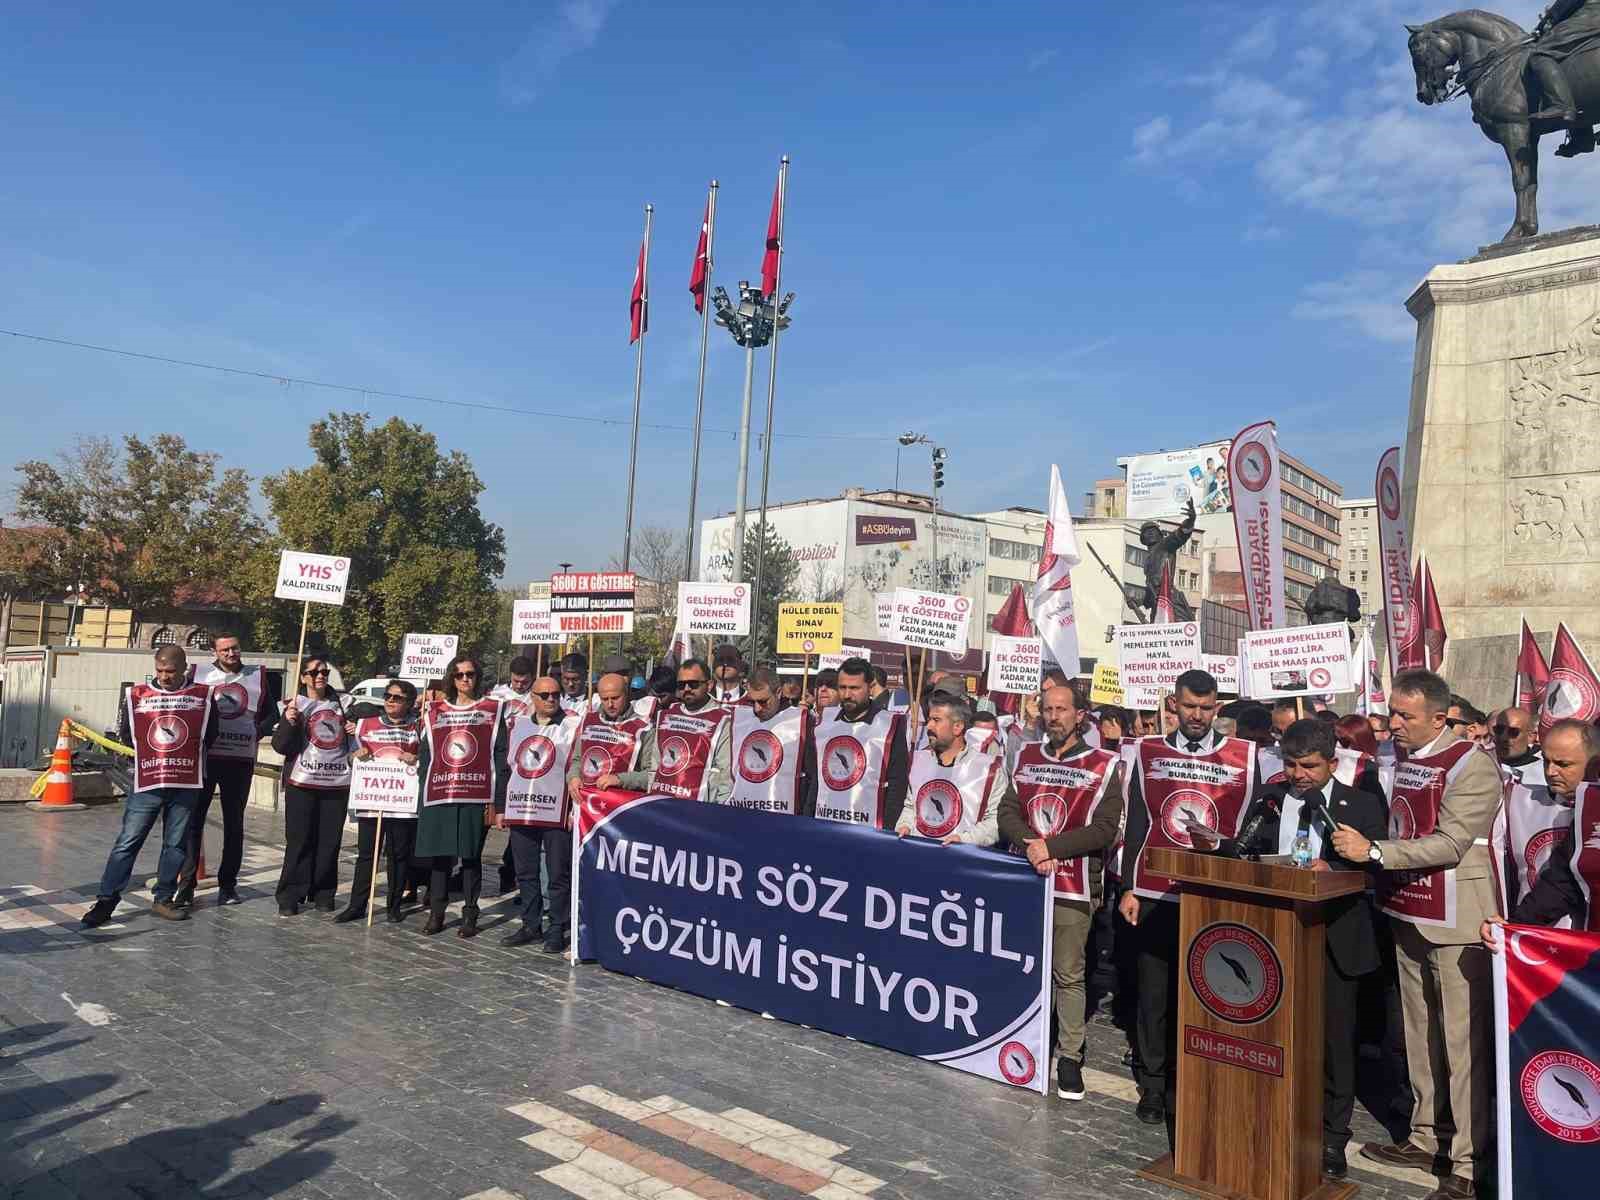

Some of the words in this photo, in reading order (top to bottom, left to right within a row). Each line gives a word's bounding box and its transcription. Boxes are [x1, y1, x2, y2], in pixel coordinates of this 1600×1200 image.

[862, 523, 911, 537] #ASBÜdeyim
[298, 563, 333, 580] YHS
[282, 579, 342, 593] KALDIRILSIN
[552, 574, 577, 591] 3600
[578, 574, 590, 591] EK
[591, 573, 635, 591] GÖSTERGE
[551, 595, 567, 609] TÜM
[568, 597, 590, 609] KAMU
[686, 594, 742, 608] GELİŞTİRME
[918, 595, 946, 608] 3600
[518, 609, 551, 620] GELİŞTİ
[692, 606, 735, 618] ÖDENEĞİ
[782, 605, 811, 615] HÜLLE
[896, 604, 910, 614] EK
[911, 605, 965, 622] GÖSTERGE
[523, 620, 551, 630] ÖDENE
[560, 614, 624, 631] VERİLSİN!!!
[689, 621, 737, 631] HAKKIMIZ
[796, 619, 823, 627] SINAV
[900, 614, 920, 625] İÇİN
[921, 619, 944, 629] DAHA
[946, 623, 958, 631] NE
[521, 633, 560, 641] HAKKIMIZ
[899, 624, 927, 636] KADAR
[928, 629, 957, 640] KARAR
[1250, 636, 1285, 648] MEMUR
[1286, 628, 1343, 642] EMEKLİLERİ
[408, 636, 432, 646] HÜLLE
[904, 634, 945, 647] ALINACAK
[1123, 640, 1168, 649] MEMLEKETE
[1170, 638, 1194, 647] TAYİN
[420, 645, 445, 655] DEĞİL
[1015, 643, 1040, 655] 3600
[1301, 643, 1324, 654] LİRA
[405, 655, 434, 665] SINAV
[996, 653, 1008, 662] EK
[1146, 651, 1171, 659] HAYAL
[1282, 657, 1308, 667] MAAŞ
[1310, 654, 1346, 665] ALIYOR
[409, 665, 448, 675] İSTİYORU
[1124, 662, 1158, 671] MEMUR
[1159, 660, 1193, 670] KİRAYI
[1000, 673, 1025, 681] KADAR
[1128, 675, 1155, 684] NASIL
[1005, 681, 1038, 691] ALINACA
[141, 757, 194, 769] ÜNİPERSEN
[1159, 760, 1210, 772] HAKLARIMIZ
[1211, 766, 1229, 777] İÇİN
[362, 775, 405, 790] TAYİN
[432, 771, 486, 784] ÜNİPERSEN
[354, 792, 390, 802] SİSTEMİ
[391, 795, 414, 803] ŞART
[509, 790, 557, 804] ÜNİPERSEN
[595, 835, 743, 900] MEMUR
[756, 863, 849, 923] SÖZ
[864, 885, 1037, 975] DEĞİL,
[614, 904, 762, 978] ÇÖZÜM
[776, 934, 979, 1037] İSTİYOR
[1557, 1127, 1582, 1140] 2015
